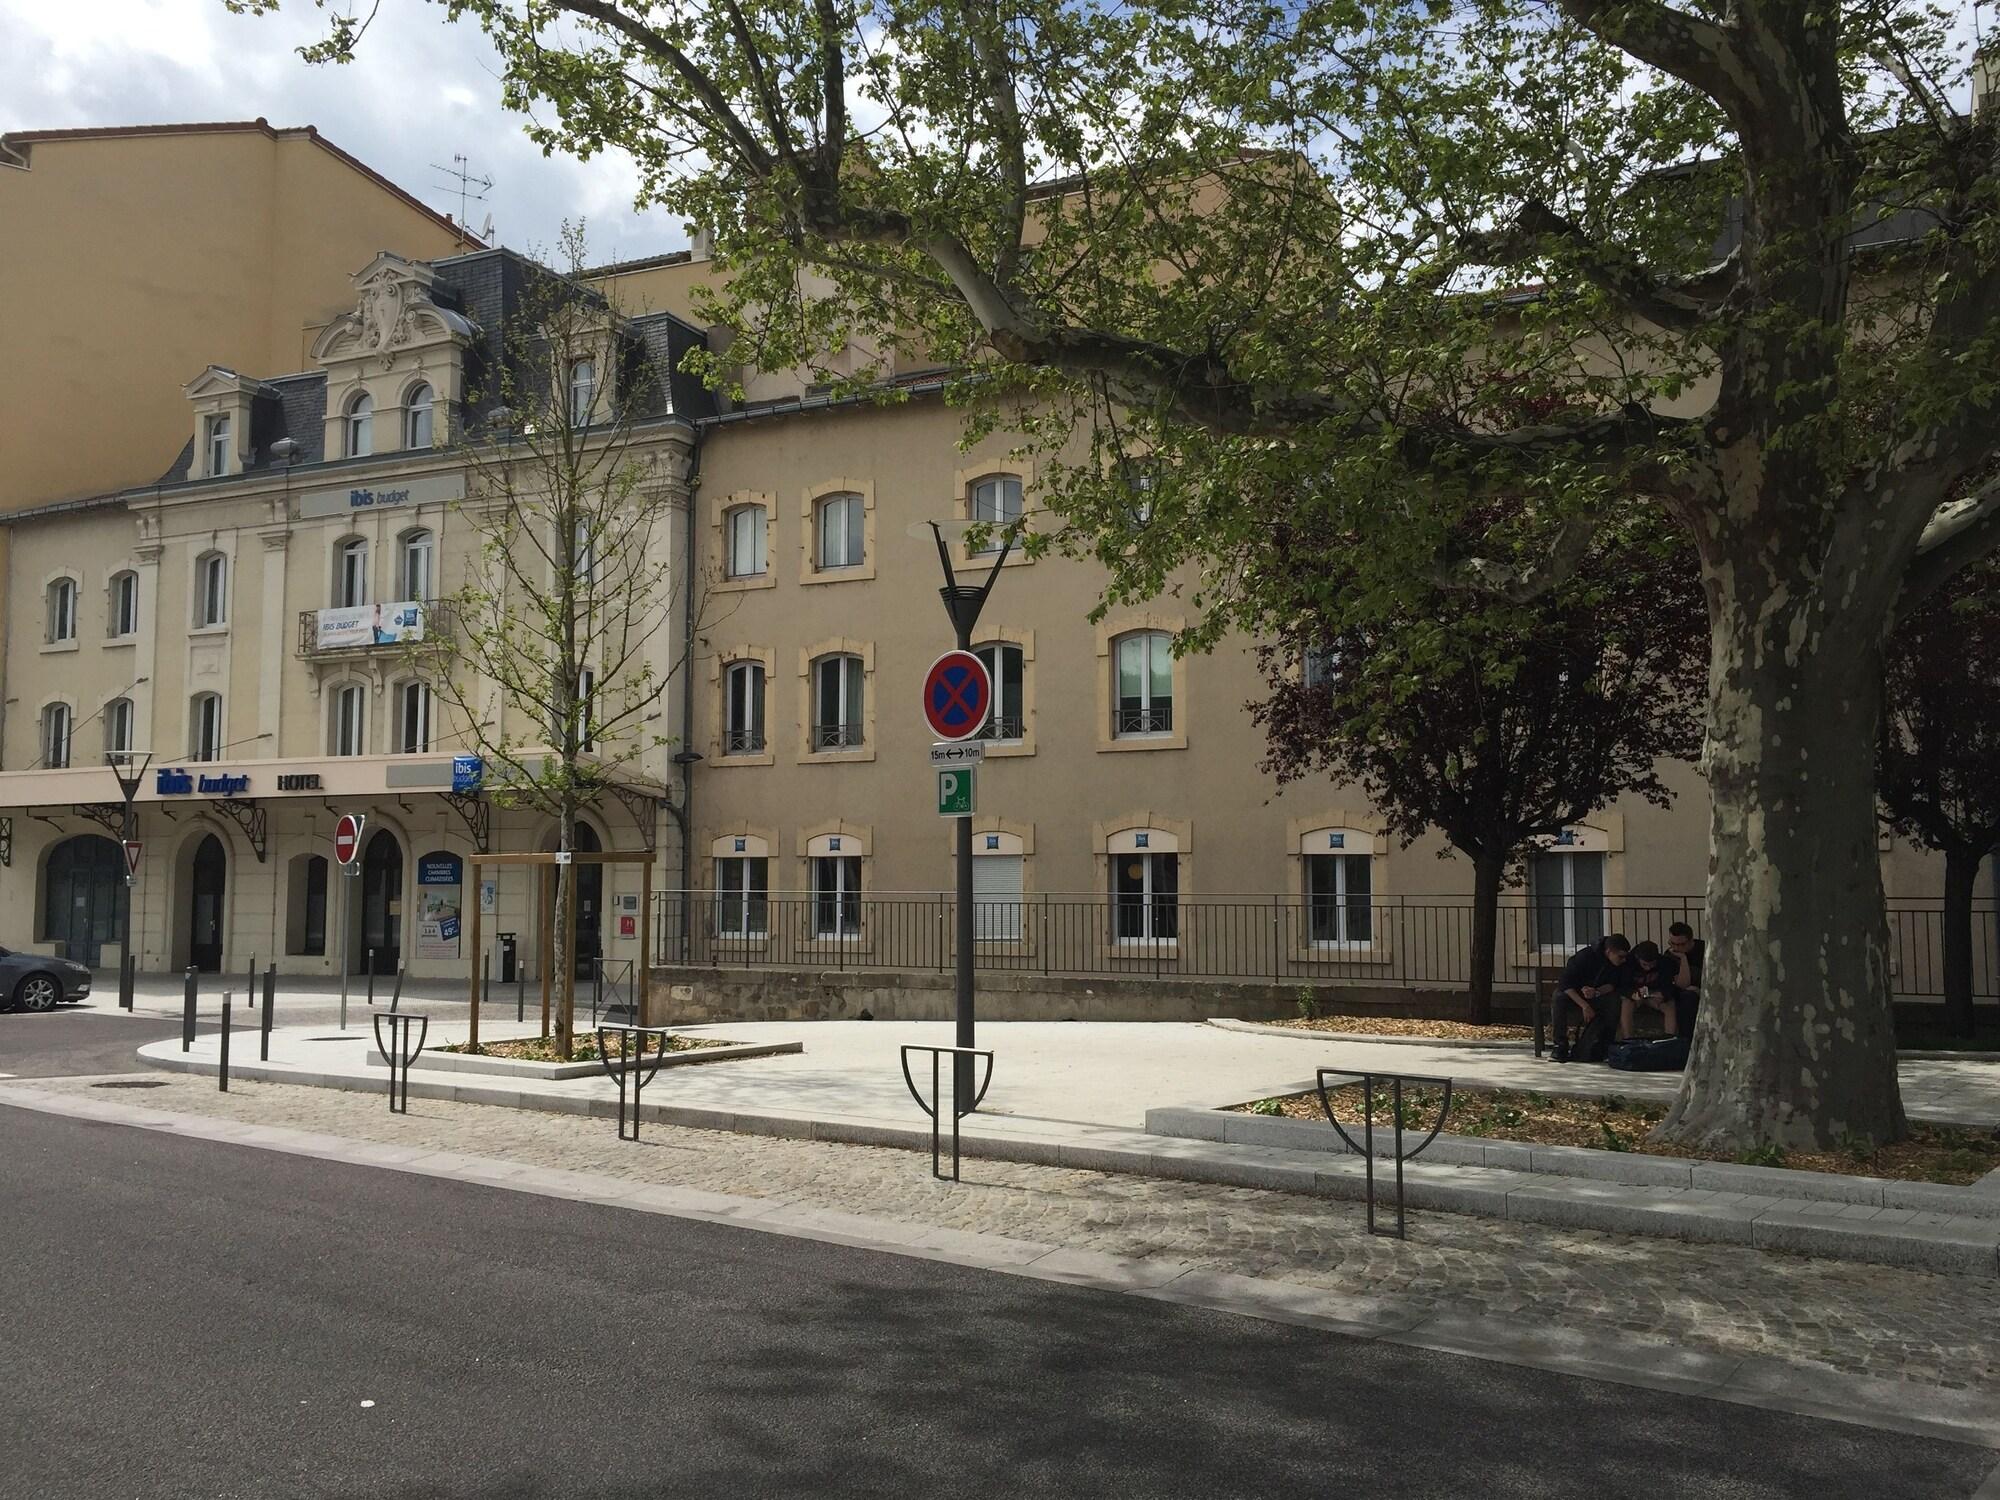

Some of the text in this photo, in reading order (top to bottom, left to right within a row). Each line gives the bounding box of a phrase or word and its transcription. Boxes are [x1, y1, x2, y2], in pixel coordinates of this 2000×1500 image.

[350, 489, 409, 507] ibis budget
[322, 620, 360, 631] IBIS BUDGET
[931, 748, 980, 760] 15m 10m
[455, 762, 471, 774] ibis
[157, 768, 250, 797] ibis budget
[277, 774, 324, 791] HOTEL
[940, 773, 958, 806] P
